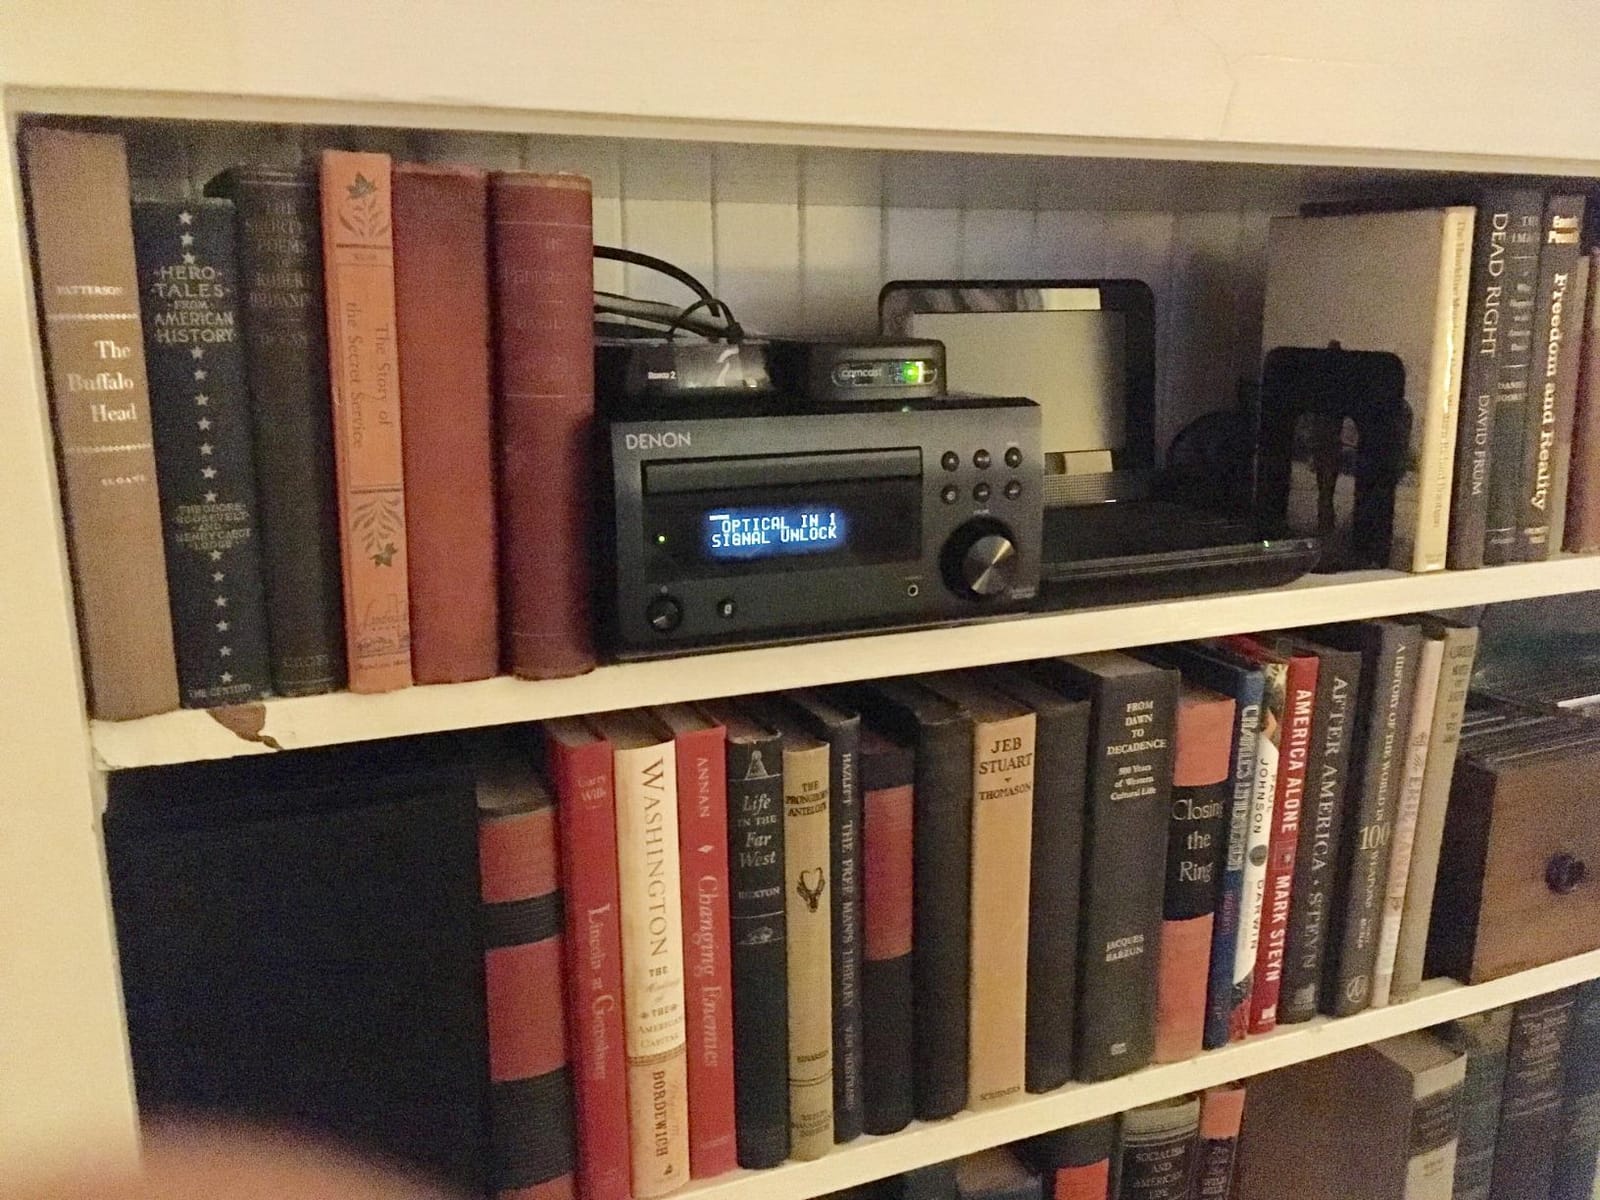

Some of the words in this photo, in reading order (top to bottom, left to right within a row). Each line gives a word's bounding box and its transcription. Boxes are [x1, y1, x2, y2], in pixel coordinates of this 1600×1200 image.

[1488, 213, 1509, 277] DEAD
[161, 266, 215, 280] HERO
[154, 283, 224, 299] TALES
[154, 311, 234, 327] AMERICAN
[347, 302, 361, 329] the
[1479, 286, 1502, 357] RIGHT
[1546, 273, 1568, 377] Freedom
[157, 328, 234, 344] HISTORY
[375, 323, 389, 352] The
[94, 339, 131, 359] The
[349, 336, 362, 385] Secret
[66, 372, 134, 391] Buffalo
[375, 361, 391, 401] Story
[90, 403, 137, 423] Head
[1542, 382, 1556, 424] and
[350, 392, 364, 450] Service
[378, 410, 393, 430] of
[1474, 394, 1490, 445] DAVID
[625, 431, 692, 450] DENON
[1471, 451, 1486, 495] FRUM
[1531, 431, 1554, 511] Reality
[721, 516, 789, 533] OPTICAL
[801, 514, 819, 528] IN
[829, 512, 837, 526] 1
[711, 531, 771, 548] SIGNAL
[780, 525, 837, 542] UNLOCK
[1396, 643, 1406, 653] A
[1389, 656, 1404, 709] HISTORY
[1126, 700, 1155, 713] FROM
[1324, 677, 1348, 757] AFTER
[1124, 713, 1154, 727] DAWN
[1287, 689, 1313, 772] AMERICA
[1389, 712, 1397, 729] OF
[1131, 728, 1145, 738] TO
[991, 737, 1022, 754] JEB
[1106, 738, 1168, 756] DECADENCE
[1385, 734, 1394, 757] THE
[978, 753, 1033, 775] STUART
[697, 758, 710, 818] ANNAN
[802, 780, 819, 793] THE
[978, 783, 1033, 801] THOMASON
[1378, 758, 1392, 806] WORLD
[742, 793, 771, 816] Life
[1253, 758, 1269, 834] JOHNSON
[1281, 777, 1302, 834] ALONE
[1311, 764, 1338, 871] AMERICA
[745, 832, 772, 848] Far
[842, 820, 854, 854] THE
[1187, 829, 1212, 851] the
[1360, 822, 1391, 850] 100
[641, 756, 670, 957] WASHINGTON
[740, 850, 777, 869] West
[842, 859, 854, 895] FREE
[1178, 860, 1216, 884] Ring
[1271, 875, 1292, 924] MARK
[588, 903, 612, 969] Lincoln
[1105, 934, 1145, 952] JACQUES
[1105, 946, 1144, 962] BARZUN
[1265, 928, 1285, 982] STEYN
[651, 1070, 669, 1158] BORDEWICH
